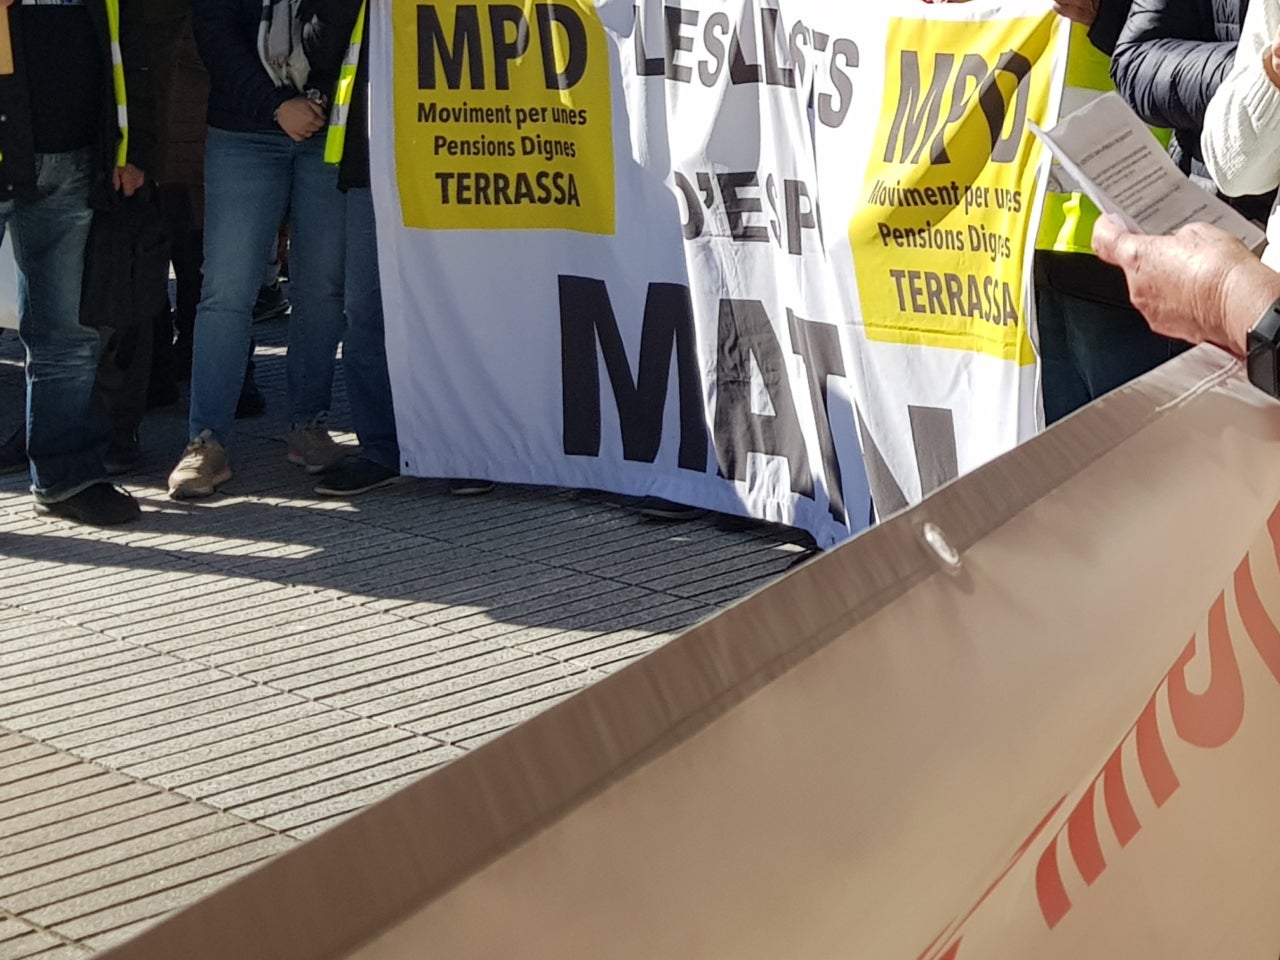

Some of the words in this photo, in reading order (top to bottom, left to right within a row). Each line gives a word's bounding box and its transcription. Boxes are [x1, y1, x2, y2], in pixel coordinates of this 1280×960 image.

[416, 3, 588, 90] MPD
[417, 102, 512, 123] Moviment
[516, 106, 546, 129] per
[551, 107, 587, 125] unes
[883, 49, 1032, 165] MPD
[433, 135, 515, 156] Pensions
[520, 134, 576, 161] Dignes
[435, 171, 581, 207] TERRASSA
[868, 180, 960, 207] Moviment
[964, 184, 990, 215] per
[877, 220, 964, 251] Pensions
[889, 268, 1019, 328] TERRASSA
